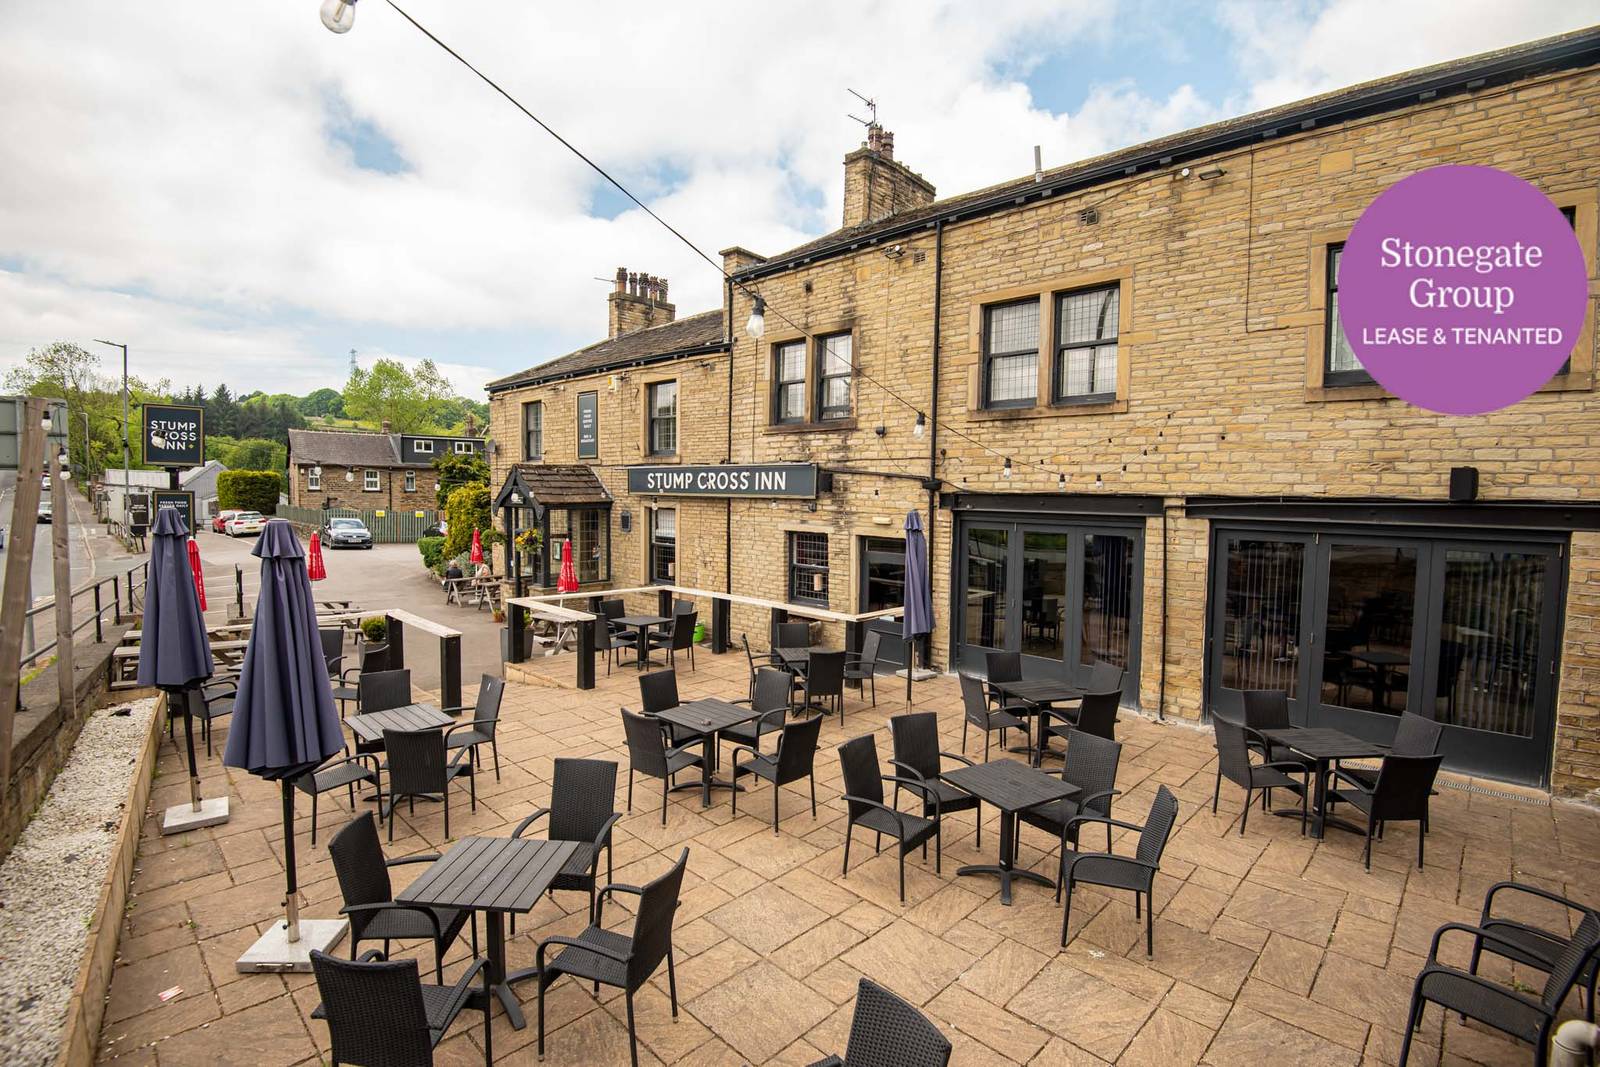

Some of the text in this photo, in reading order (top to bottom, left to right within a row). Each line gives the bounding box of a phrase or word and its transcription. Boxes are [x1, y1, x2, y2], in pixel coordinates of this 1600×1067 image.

[151, 420, 197, 431] STUMP
[647, 471, 786, 490] STUMP CROSS INN
